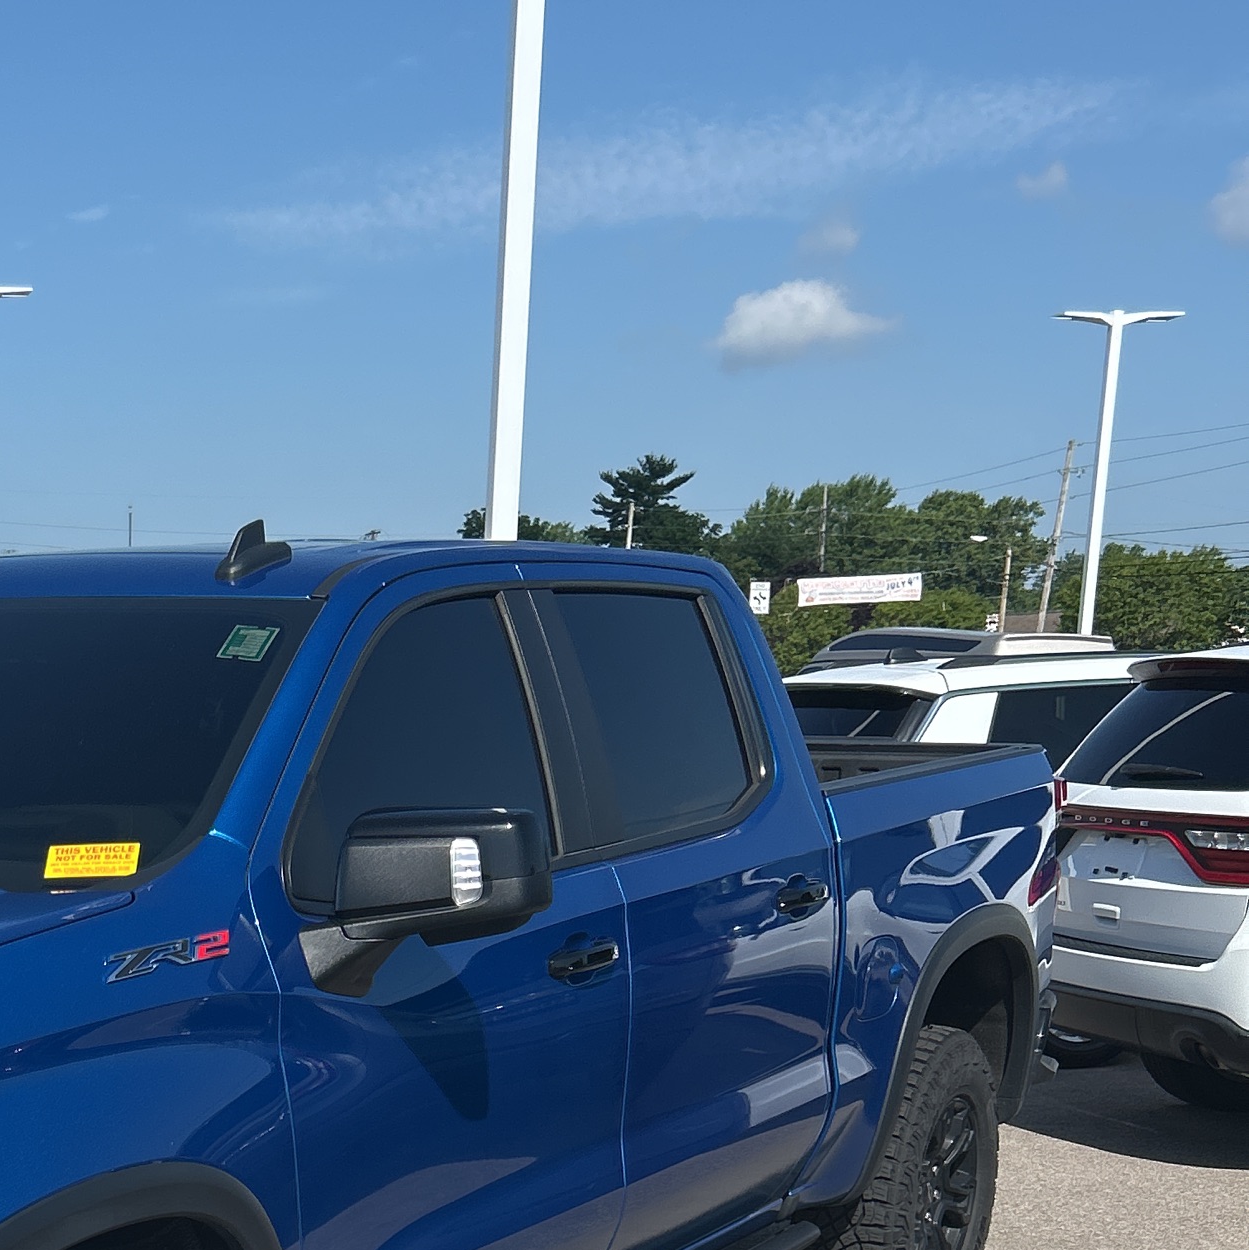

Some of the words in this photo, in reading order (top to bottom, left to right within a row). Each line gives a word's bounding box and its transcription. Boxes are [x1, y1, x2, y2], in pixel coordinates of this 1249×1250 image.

[1075, 815, 1149, 827] DODGE
[55, 847, 81, 855] THIS
[85, 845, 136, 854] VEHICLE
[106, 929, 230, 983] ZR2
